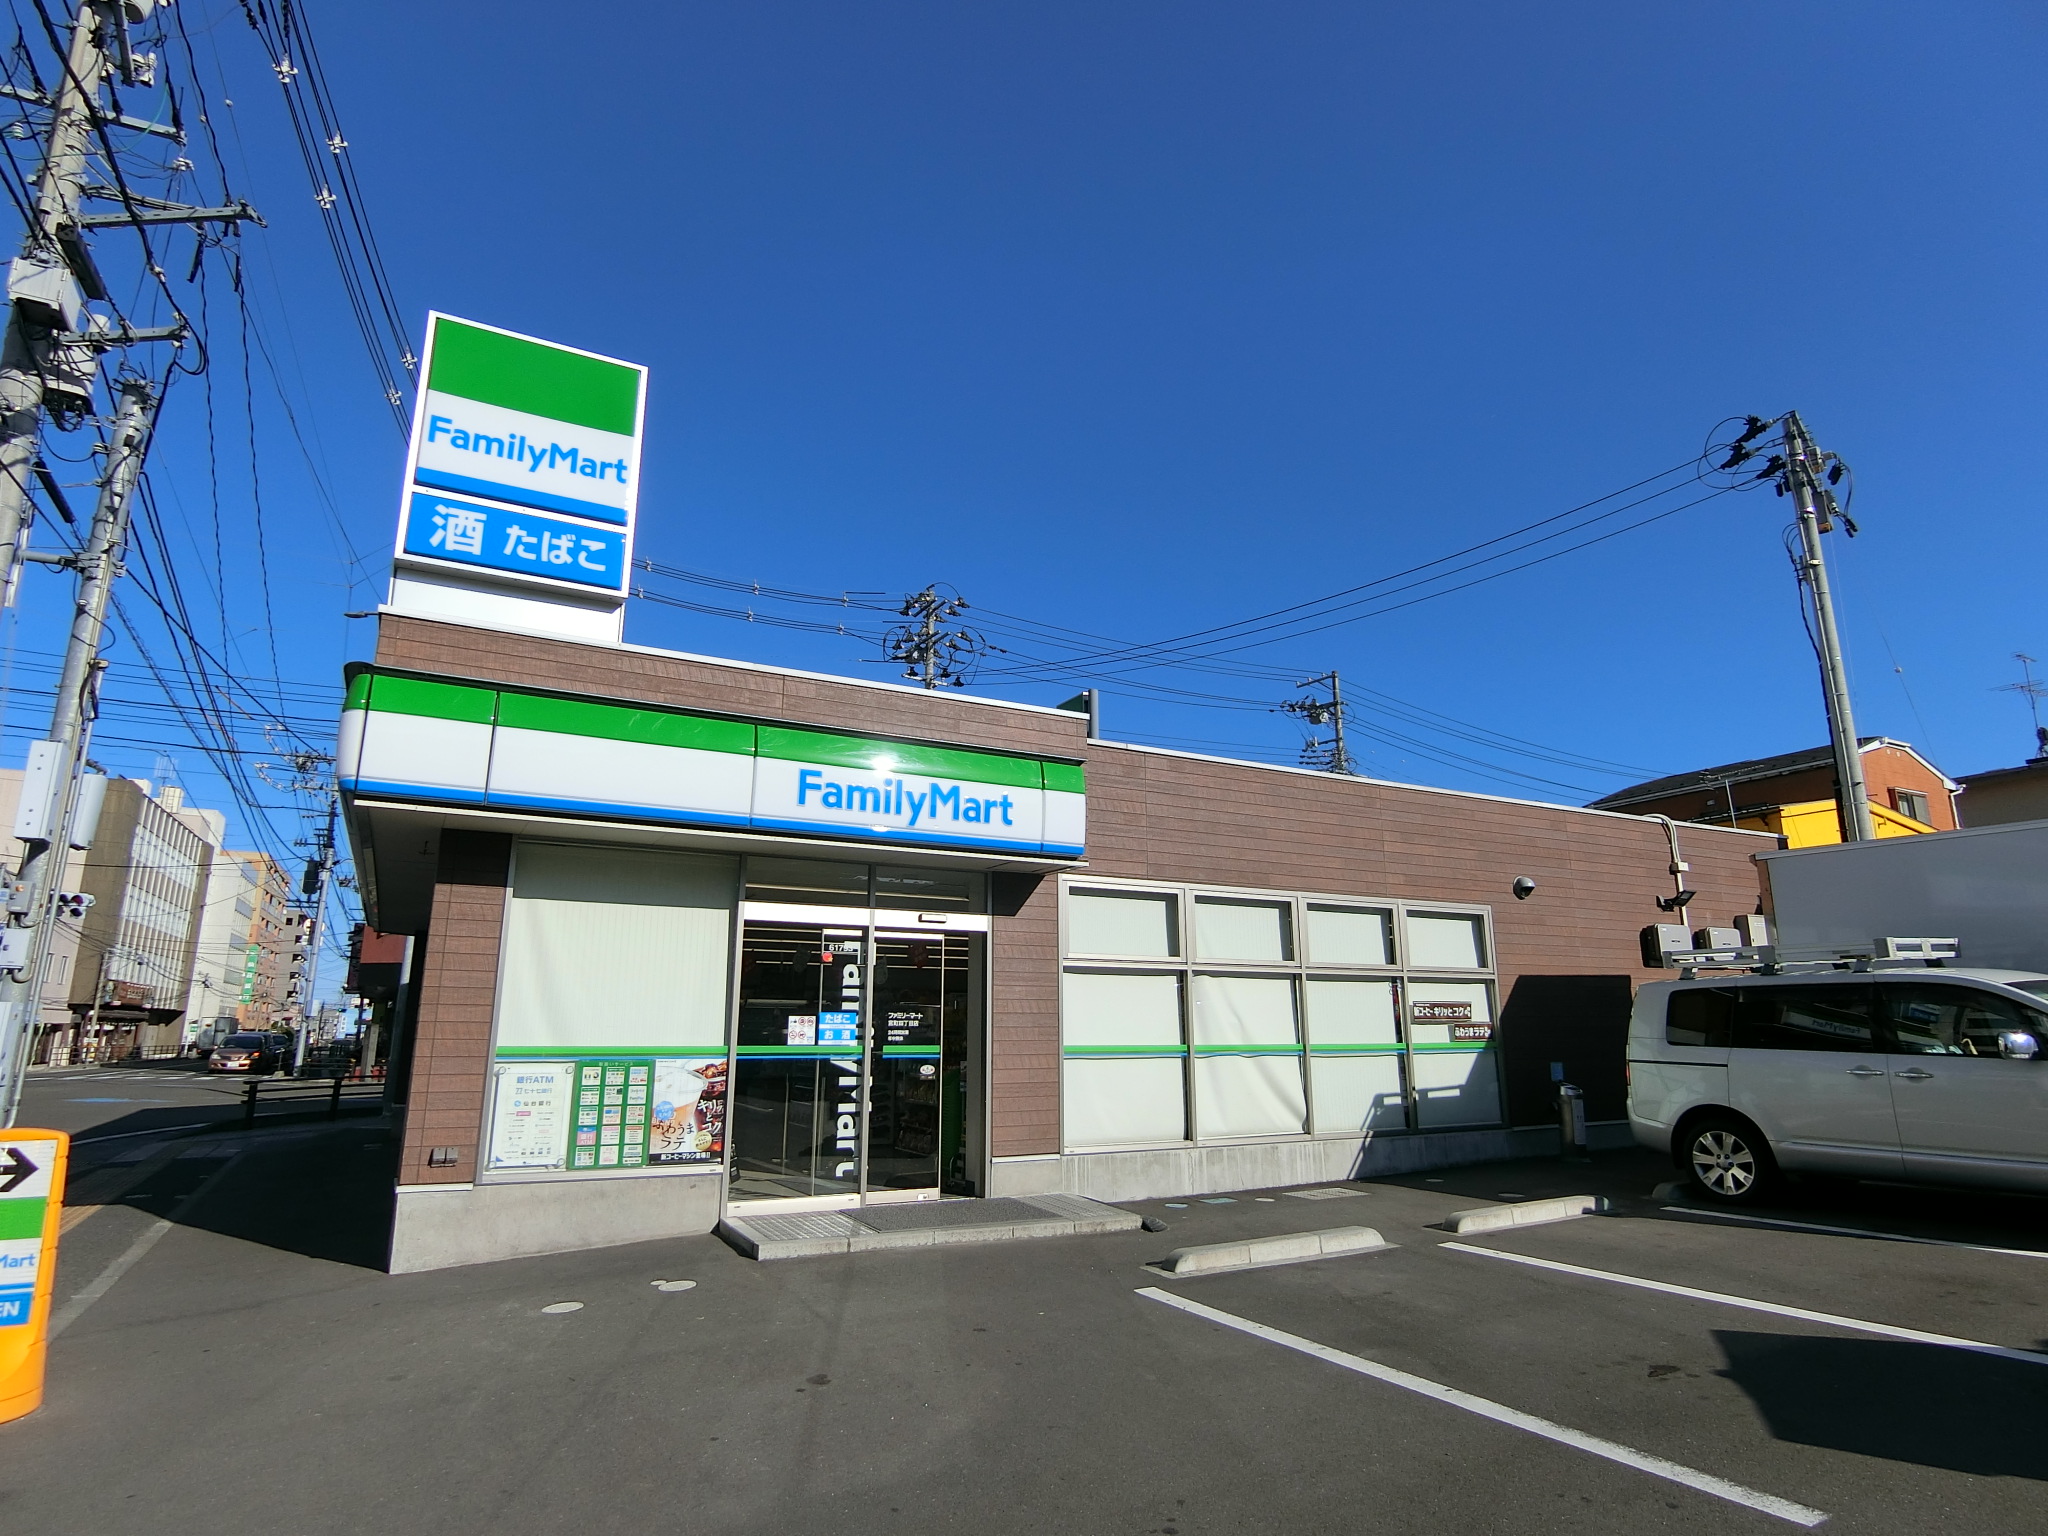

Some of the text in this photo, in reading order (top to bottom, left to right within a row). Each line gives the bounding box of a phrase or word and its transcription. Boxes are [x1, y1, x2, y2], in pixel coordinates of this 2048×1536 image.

[427, 415, 628, 484] FamilyMart
[429, 504, 606, 572] 酒 たばこ
[797, 769, 1013, 827] FamilyMart
[825, 1014, 851, 1024] たばこ
[888, 1012, 923, 1020] ファミリーマート
[824, 1029, 851, 1040] お酒
[830, 941, 877, 1177] FamyMart
[702, 1121, 722, 1135] コク
[660, 1135, 686, 1151] ラテ
